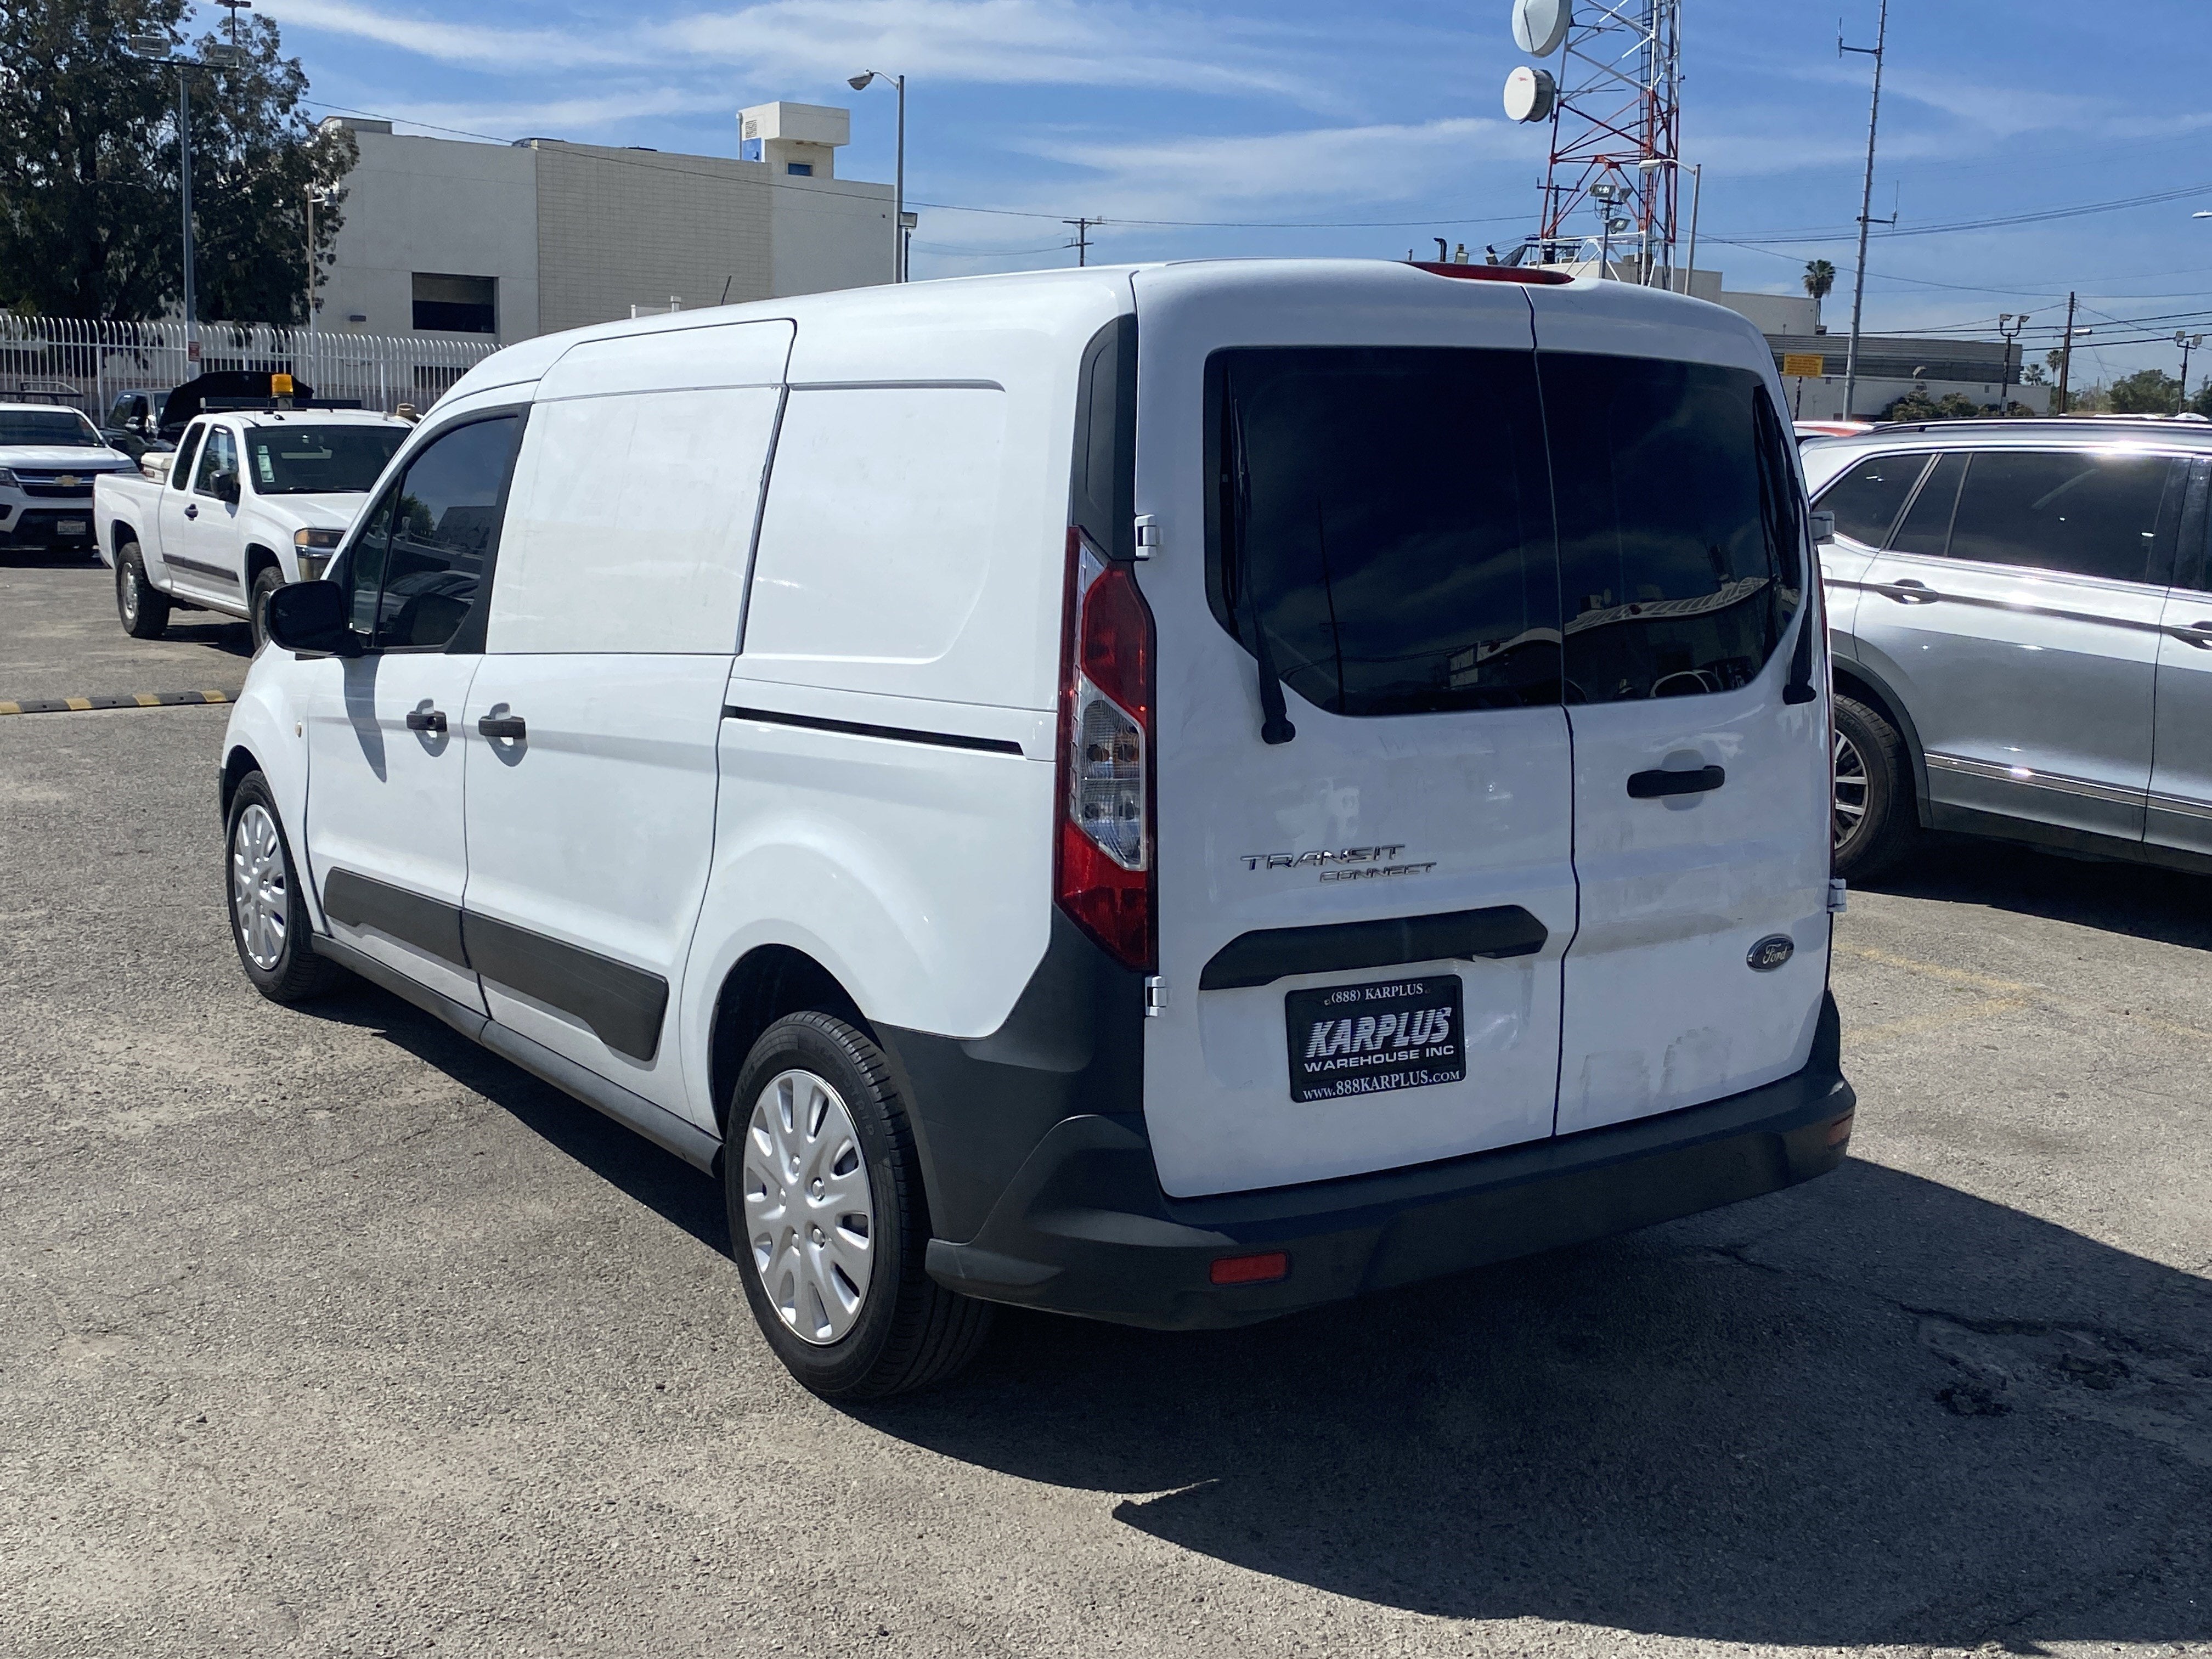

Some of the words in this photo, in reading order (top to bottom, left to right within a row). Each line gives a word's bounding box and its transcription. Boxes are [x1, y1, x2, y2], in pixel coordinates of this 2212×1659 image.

[1240, 844, 1406, 871] TRANSIT
[1319, 862, 1437, 883] CONNECT
[1331, 989, 1361, 1004] (888)
[1365, 983, 1424, 1000] KARPLUS
[1304, 1007, 1452, 1058] KARPLUS
[1304, 1049, 1420, 1073] WAREHOUSE
[1425, 1045, 1454, 1058] INC
